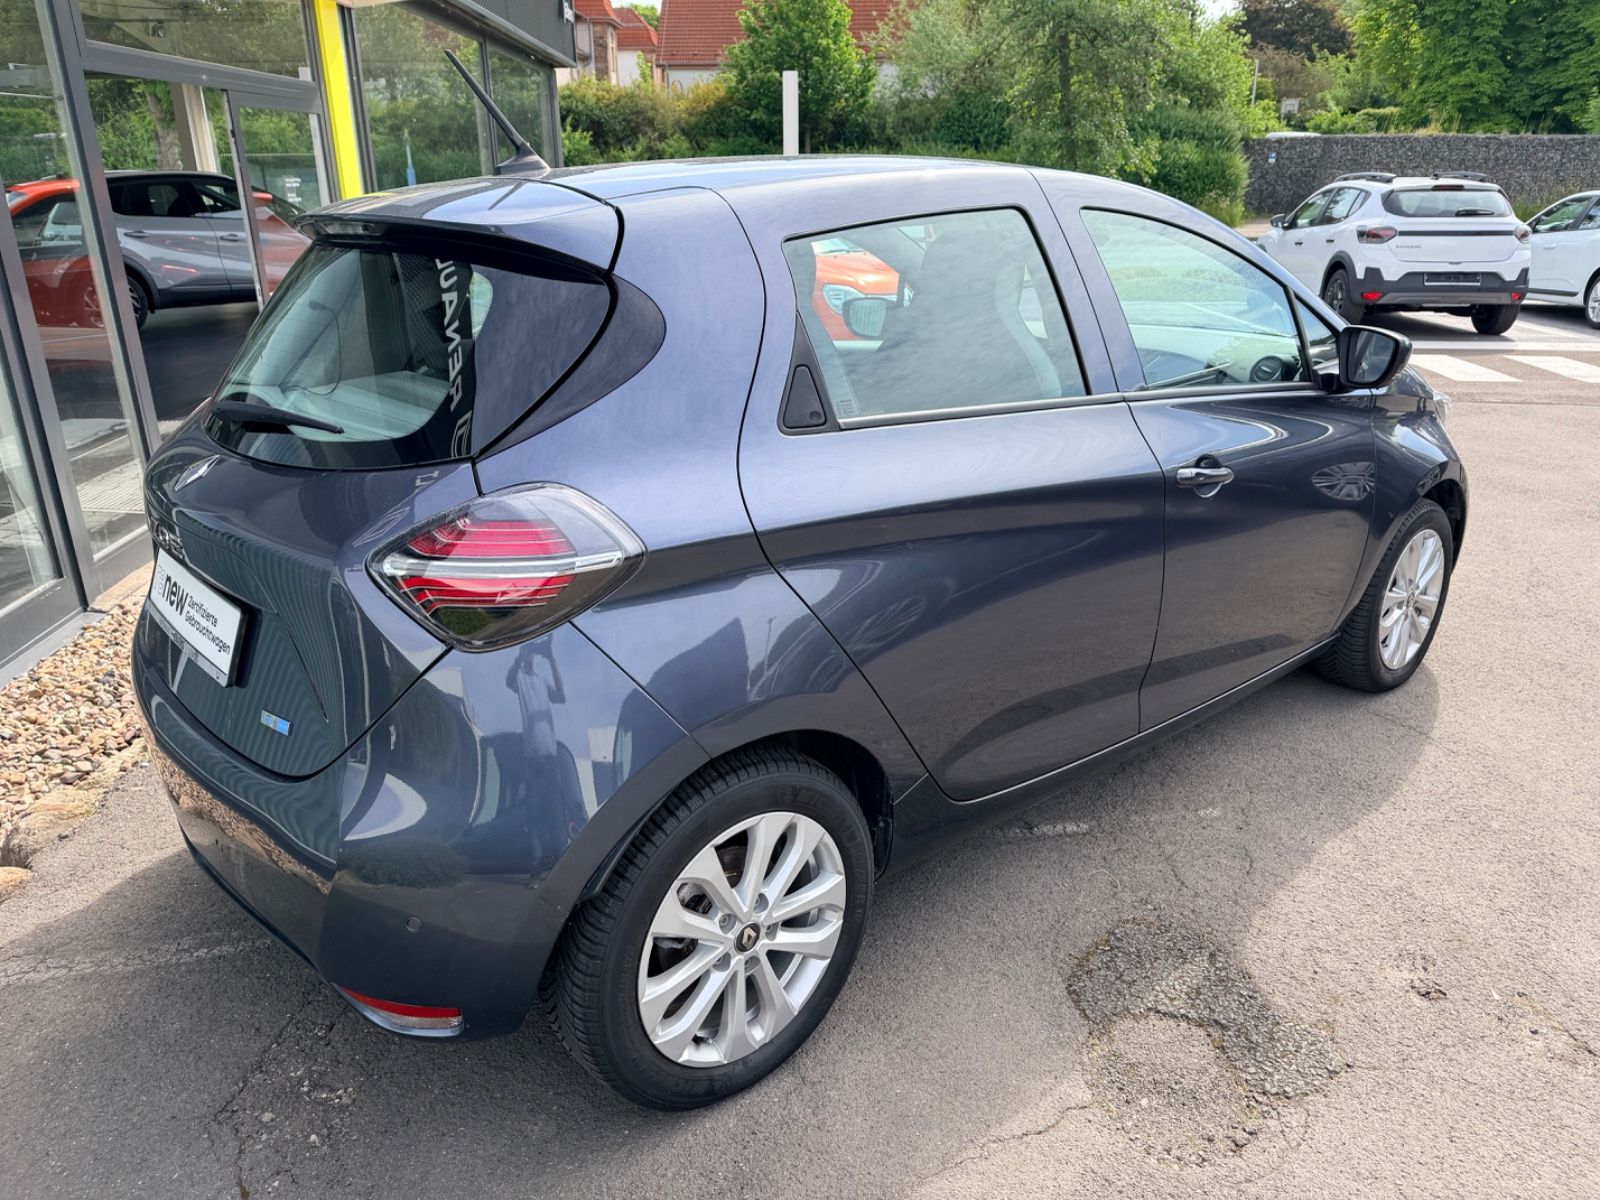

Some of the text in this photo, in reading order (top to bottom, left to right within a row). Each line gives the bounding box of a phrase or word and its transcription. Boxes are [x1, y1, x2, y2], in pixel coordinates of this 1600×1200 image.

[162, 574, 188, 616] new
[188, 595, 218, 627] Zertifizierte
[185, 610, 231, 656] Gebrauchtwagen
